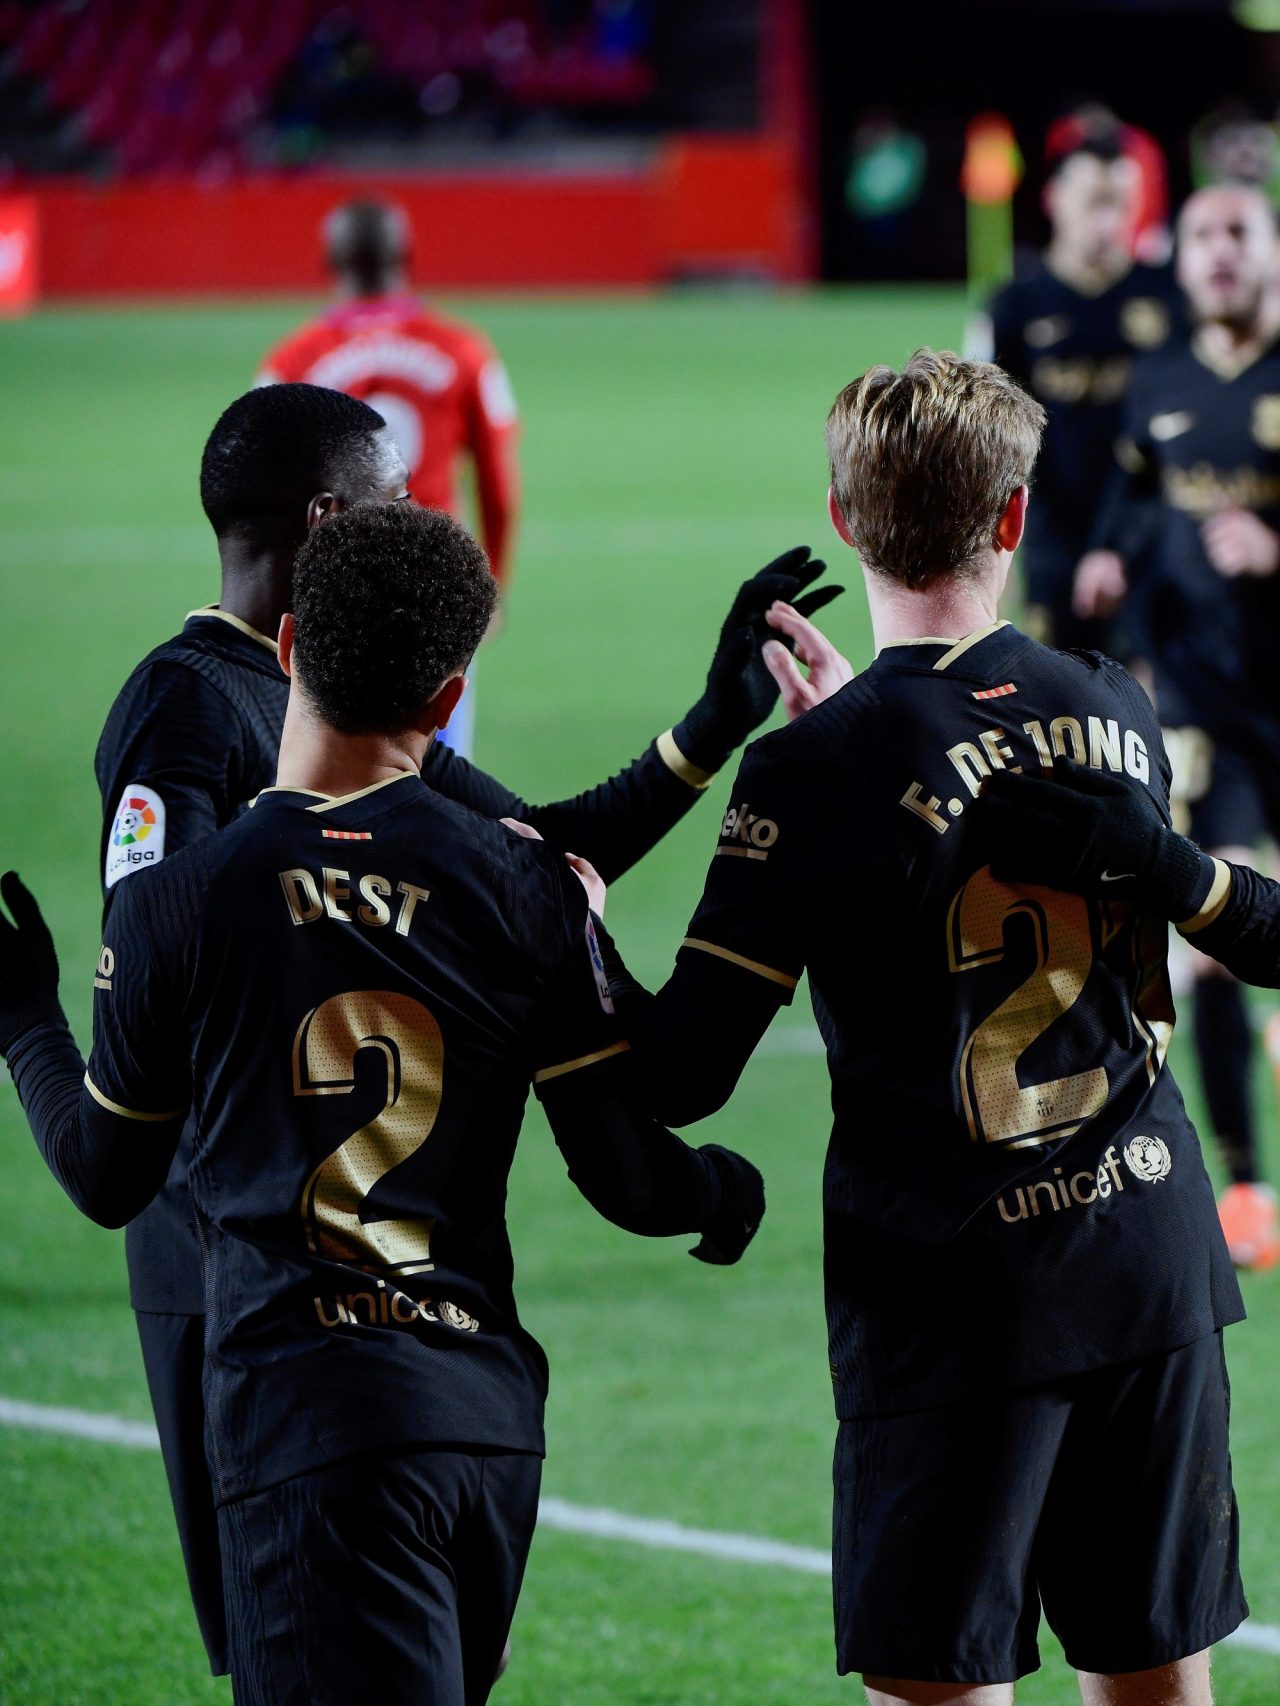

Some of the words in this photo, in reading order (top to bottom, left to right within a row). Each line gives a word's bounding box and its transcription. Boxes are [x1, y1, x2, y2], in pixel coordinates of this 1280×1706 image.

[900, 781, 964, 835] F.
[946, 727, 1023, 799] DE
[1022, 716, 1149, 786] JONG
[721, 803, 779, 848] eko
[278, 867, 430, 937] DEST
[292, 990, 445, 1277] 2
[996, 1145, 1124, 1224] unicef
